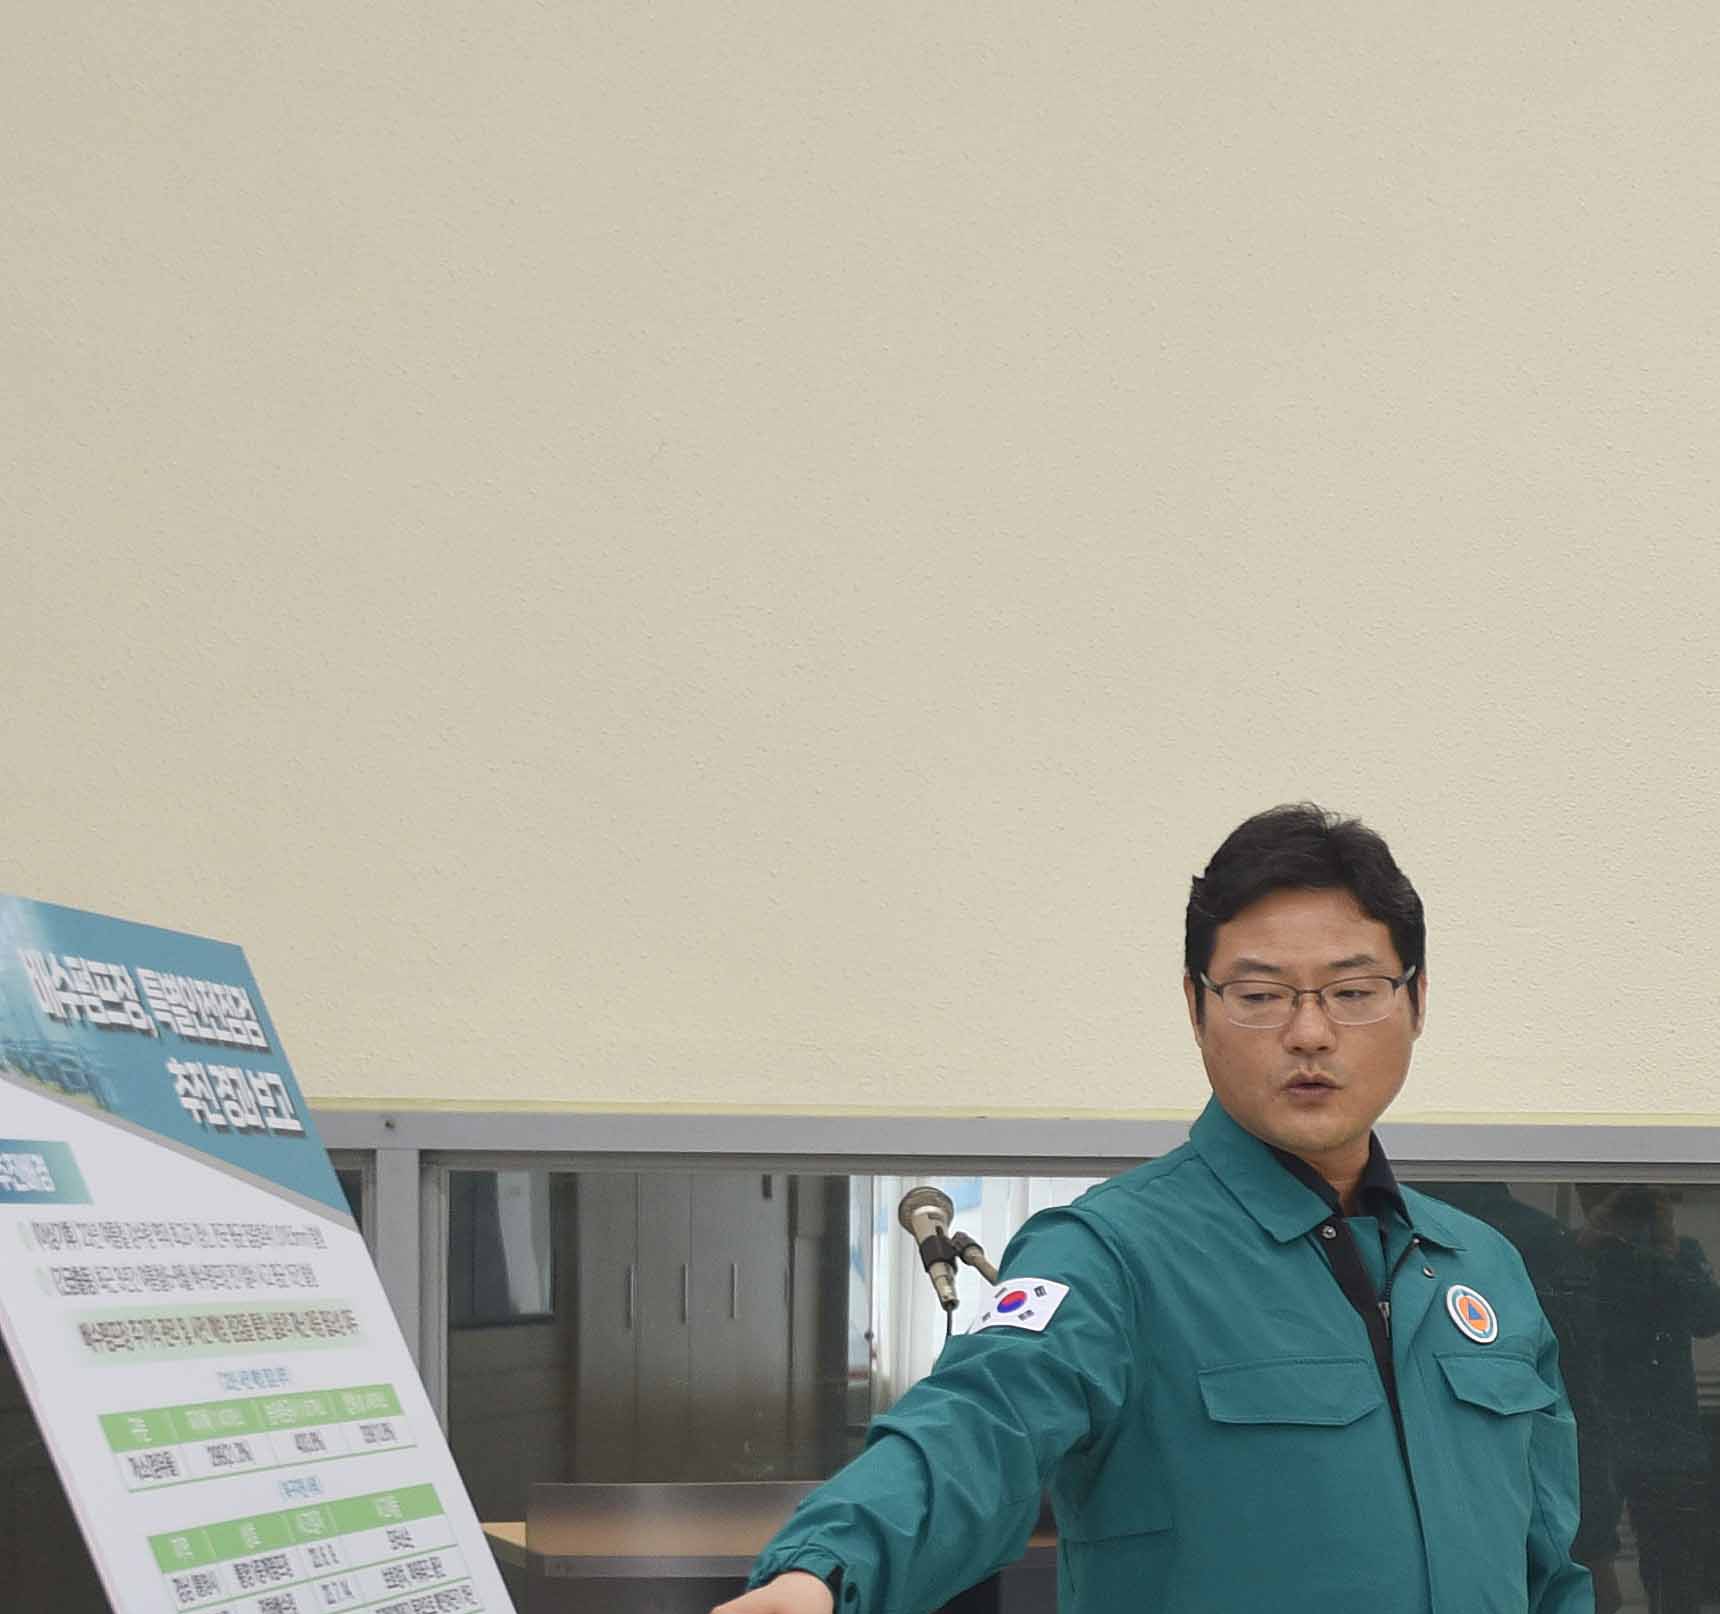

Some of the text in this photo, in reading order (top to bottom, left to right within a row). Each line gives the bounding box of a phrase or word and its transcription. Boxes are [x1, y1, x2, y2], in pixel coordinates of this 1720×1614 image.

[134, 967, 271, 1050] 특별안전점검
[161, 1056, 305, 1133] 추진 경과 보고
